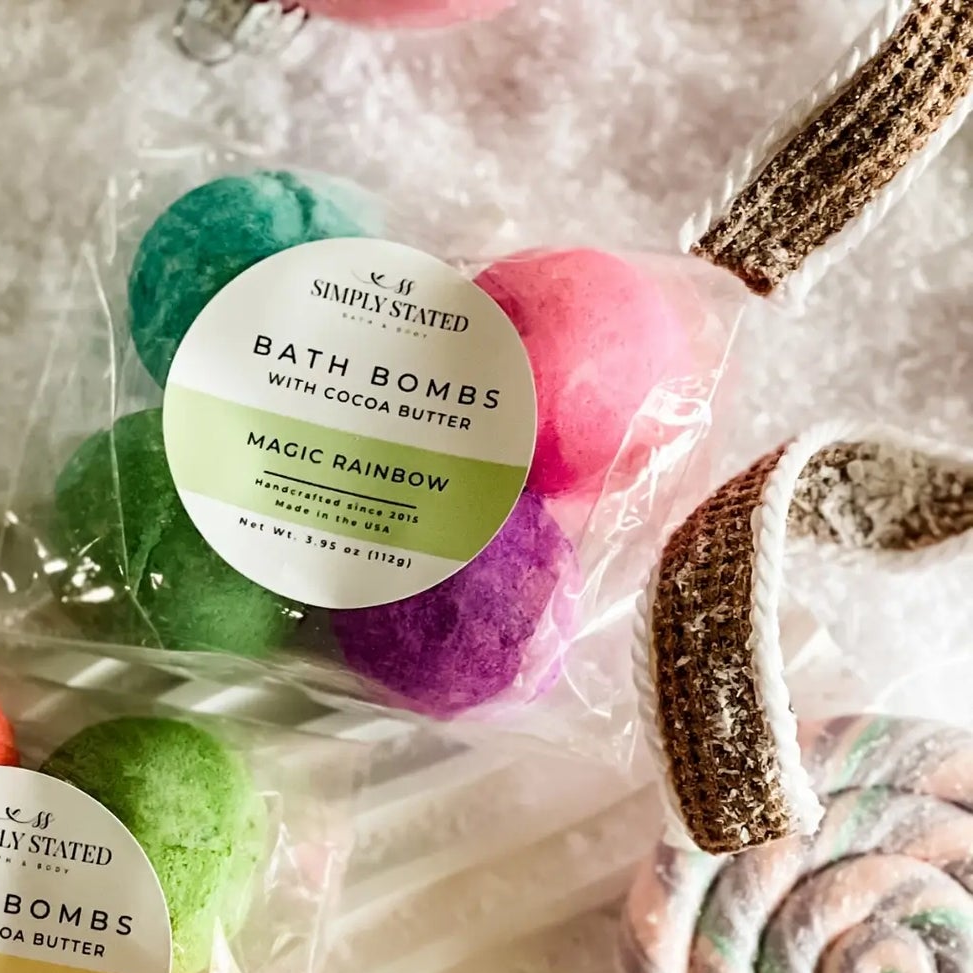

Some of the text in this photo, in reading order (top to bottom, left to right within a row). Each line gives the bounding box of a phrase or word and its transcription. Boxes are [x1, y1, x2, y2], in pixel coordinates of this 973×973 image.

[310, 279, 469, 334] SIMPLY STATED
[253, 335, 500, 409] BATH BOMBS
[268, 371, 471, 430] WITH COCOA BUTTER
[247, 432, 450, 492] MAGIC RAINBOW
[255, 478, 419, 524] Handcrafted since 2015
[275, 499, 390, 533] Made in the USA
[240, 517, 412, 569] Net Wt. 3.95 oz (112g)
[29, 835, 112, 867] STATED
[3, 894, 133, 936] BOMBS
[33, 933, 105, 957] BUTTER
